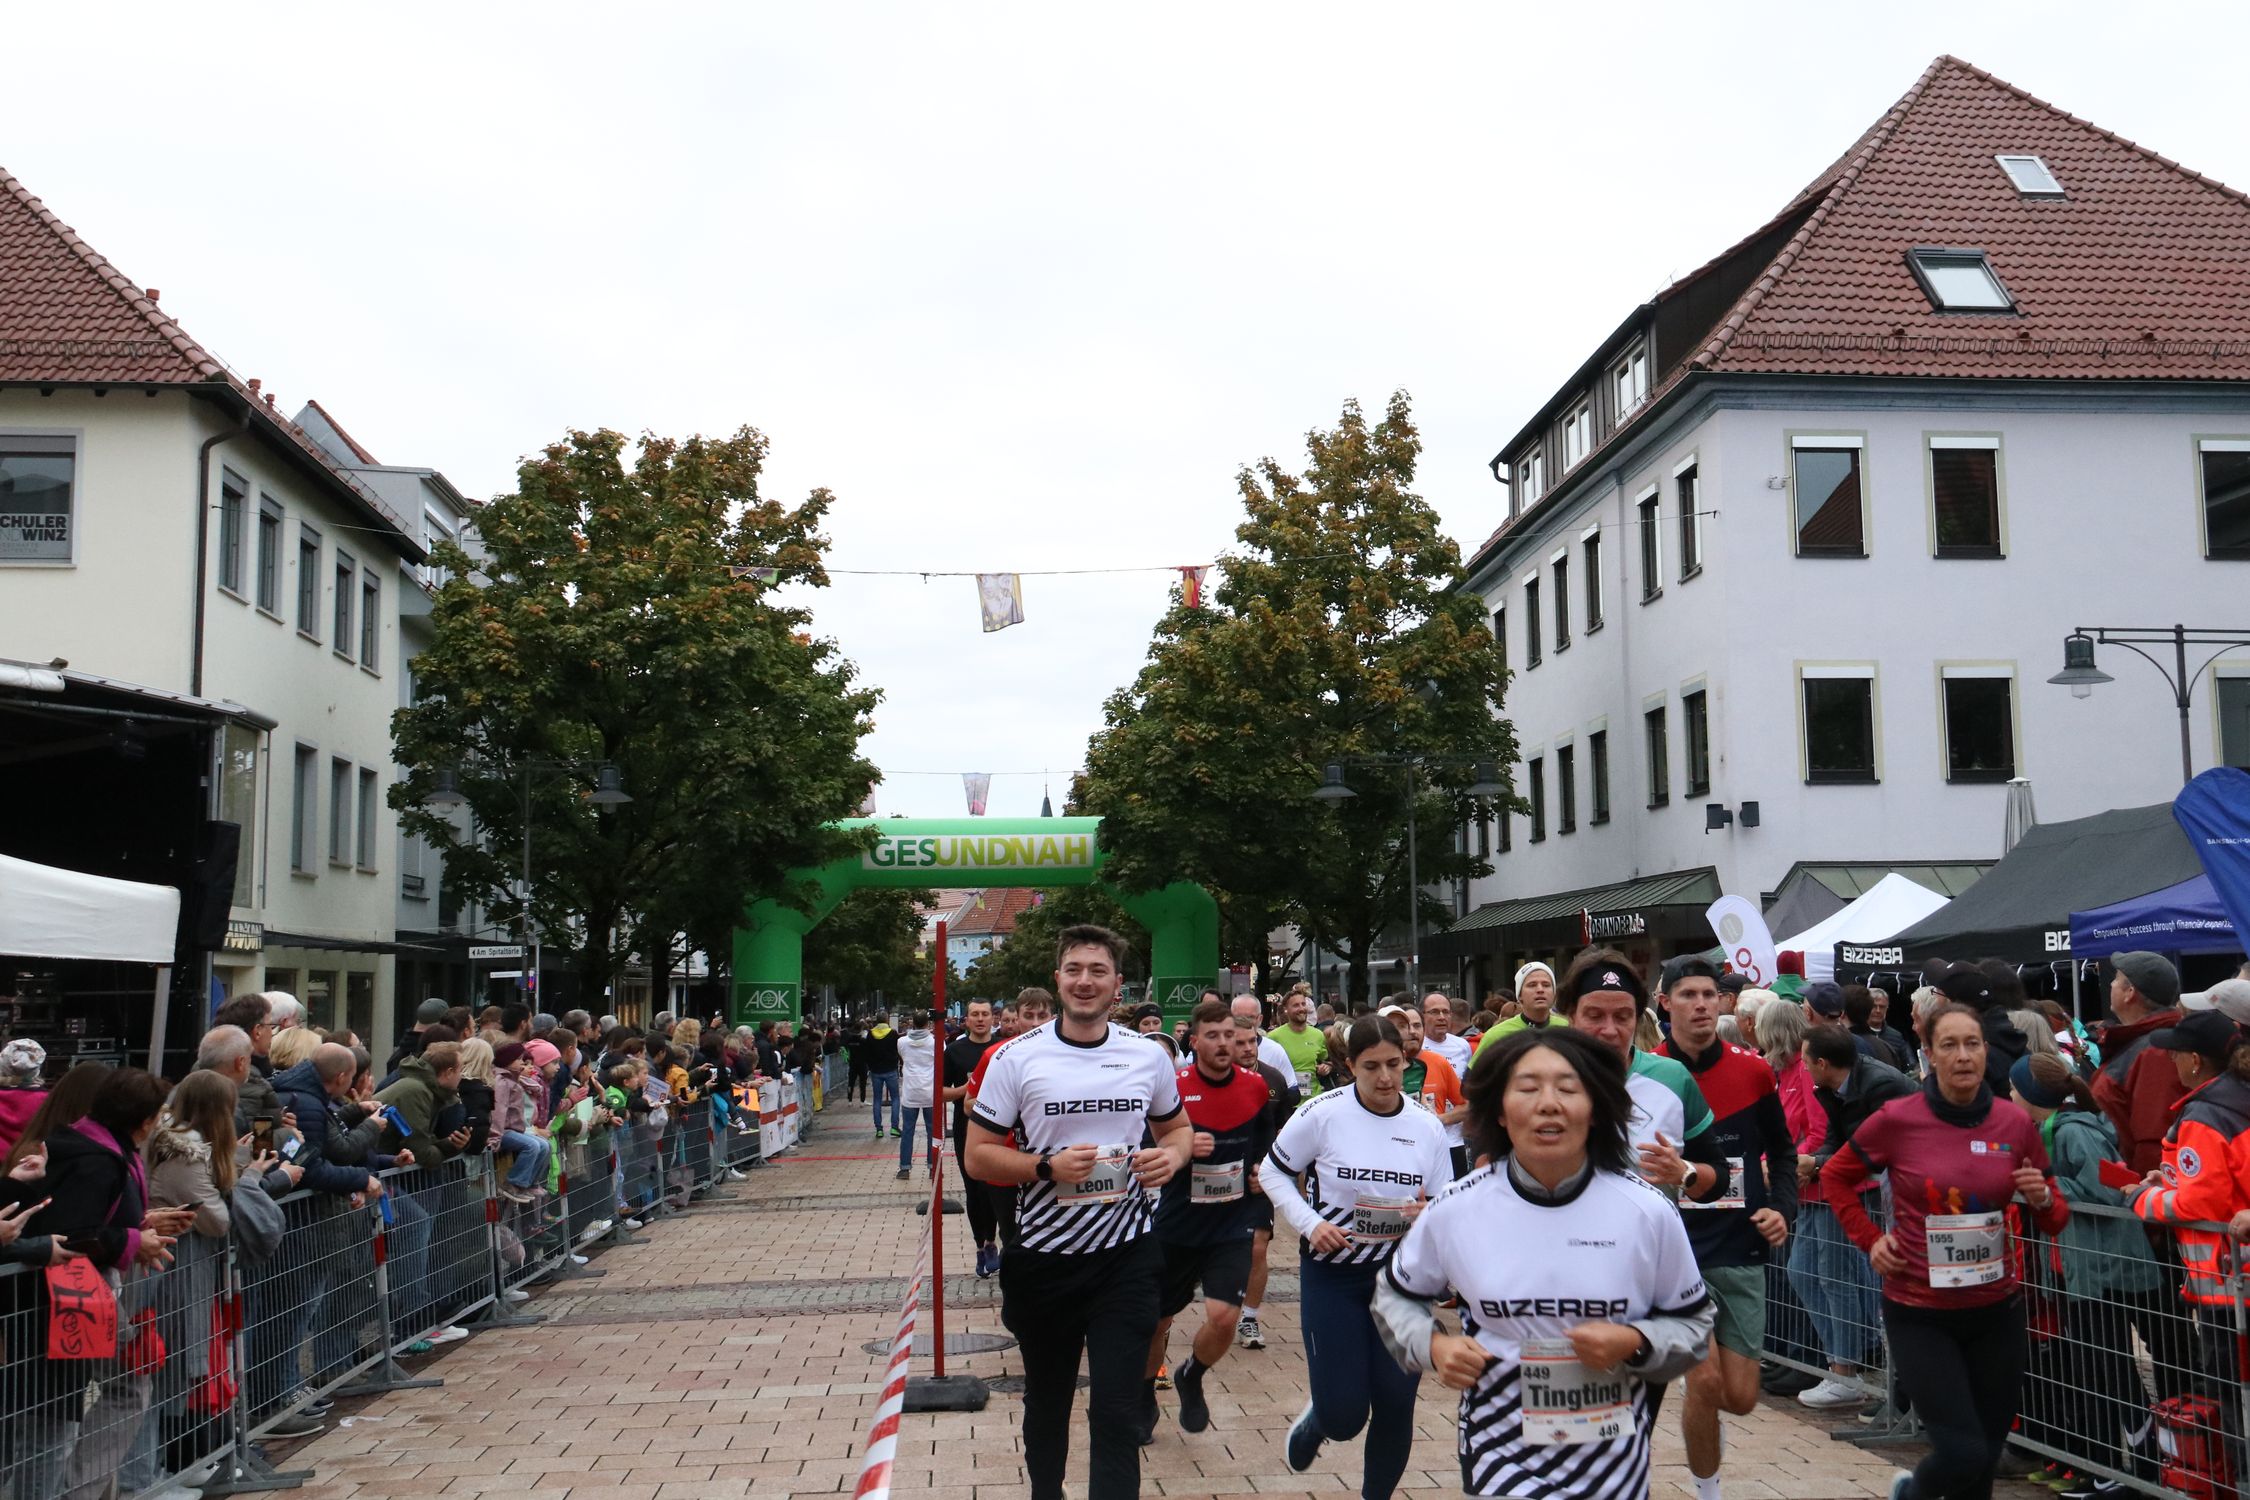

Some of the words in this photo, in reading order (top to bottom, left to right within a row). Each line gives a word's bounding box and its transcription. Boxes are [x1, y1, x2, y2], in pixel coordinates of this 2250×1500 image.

[0, 515, 67, 528] CHULER
[2093, 926, 2129, 939] Empowering
[2129, 923, 2152, 935] success
[2153, 920, 2176, 932] through
[2176, 918, 2205, 929] financial
[489, 947, 519, 955] Spitaltörle
[1843, 947, 1903, 965] BIZERBA
[744, 990, 789, 1008] AOK
[996, 1028, 1043, 1060] BIZERBA
[1045, 1099, 1143, 1116] BIZERBA
[1300, 1090, 1344, 1117] BIZERBA
[1076, 1177, 1114, 1193] Leon
[1337, 1167, 1423, 1187] BIZERBA
[1204, 1182, 1232, 1195] René
[1355, 1209, 1371, 1218] 509
[1929, 1234, 1954, 1244] 1555
[1945, 1245, 1990, 1263] Tanja
[1980, 1270, 1999, 1283] 1555
[1480, 1298, 1628, 1319] BIZERBA
[1523, 1366, 1550, 1380] 449
[1528, 1382, 1621, 1412] Tingting
[1599, 1423, 1620, 1437] 449
